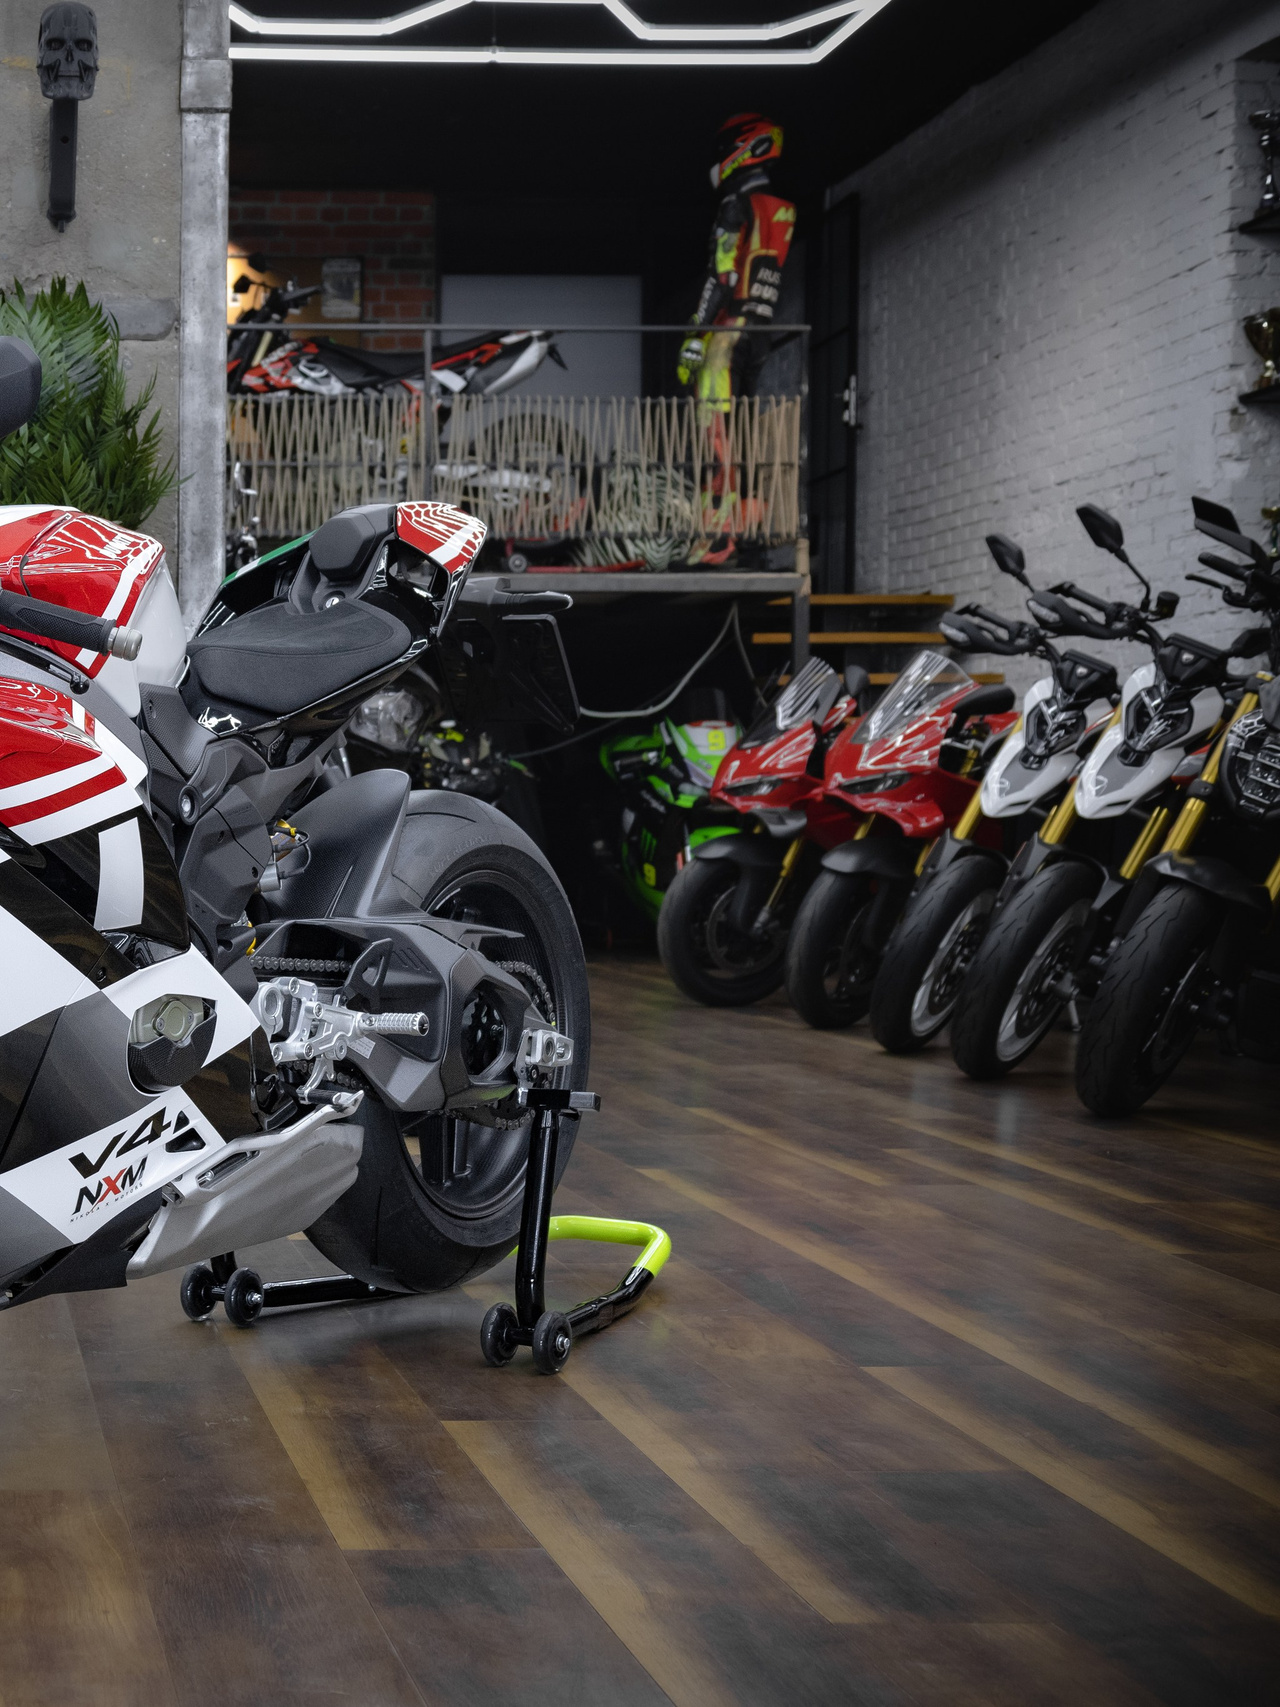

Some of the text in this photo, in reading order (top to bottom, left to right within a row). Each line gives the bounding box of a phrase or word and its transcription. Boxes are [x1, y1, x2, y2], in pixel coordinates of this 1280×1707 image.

[708, 729, 725, 750] 9
[643, 862, 657, 887] 9
[68, 1106, 172, 1179] V4
[72, 1155, 148, 1215] NXM
[114, 1182, 143, 1203] MOTORS
